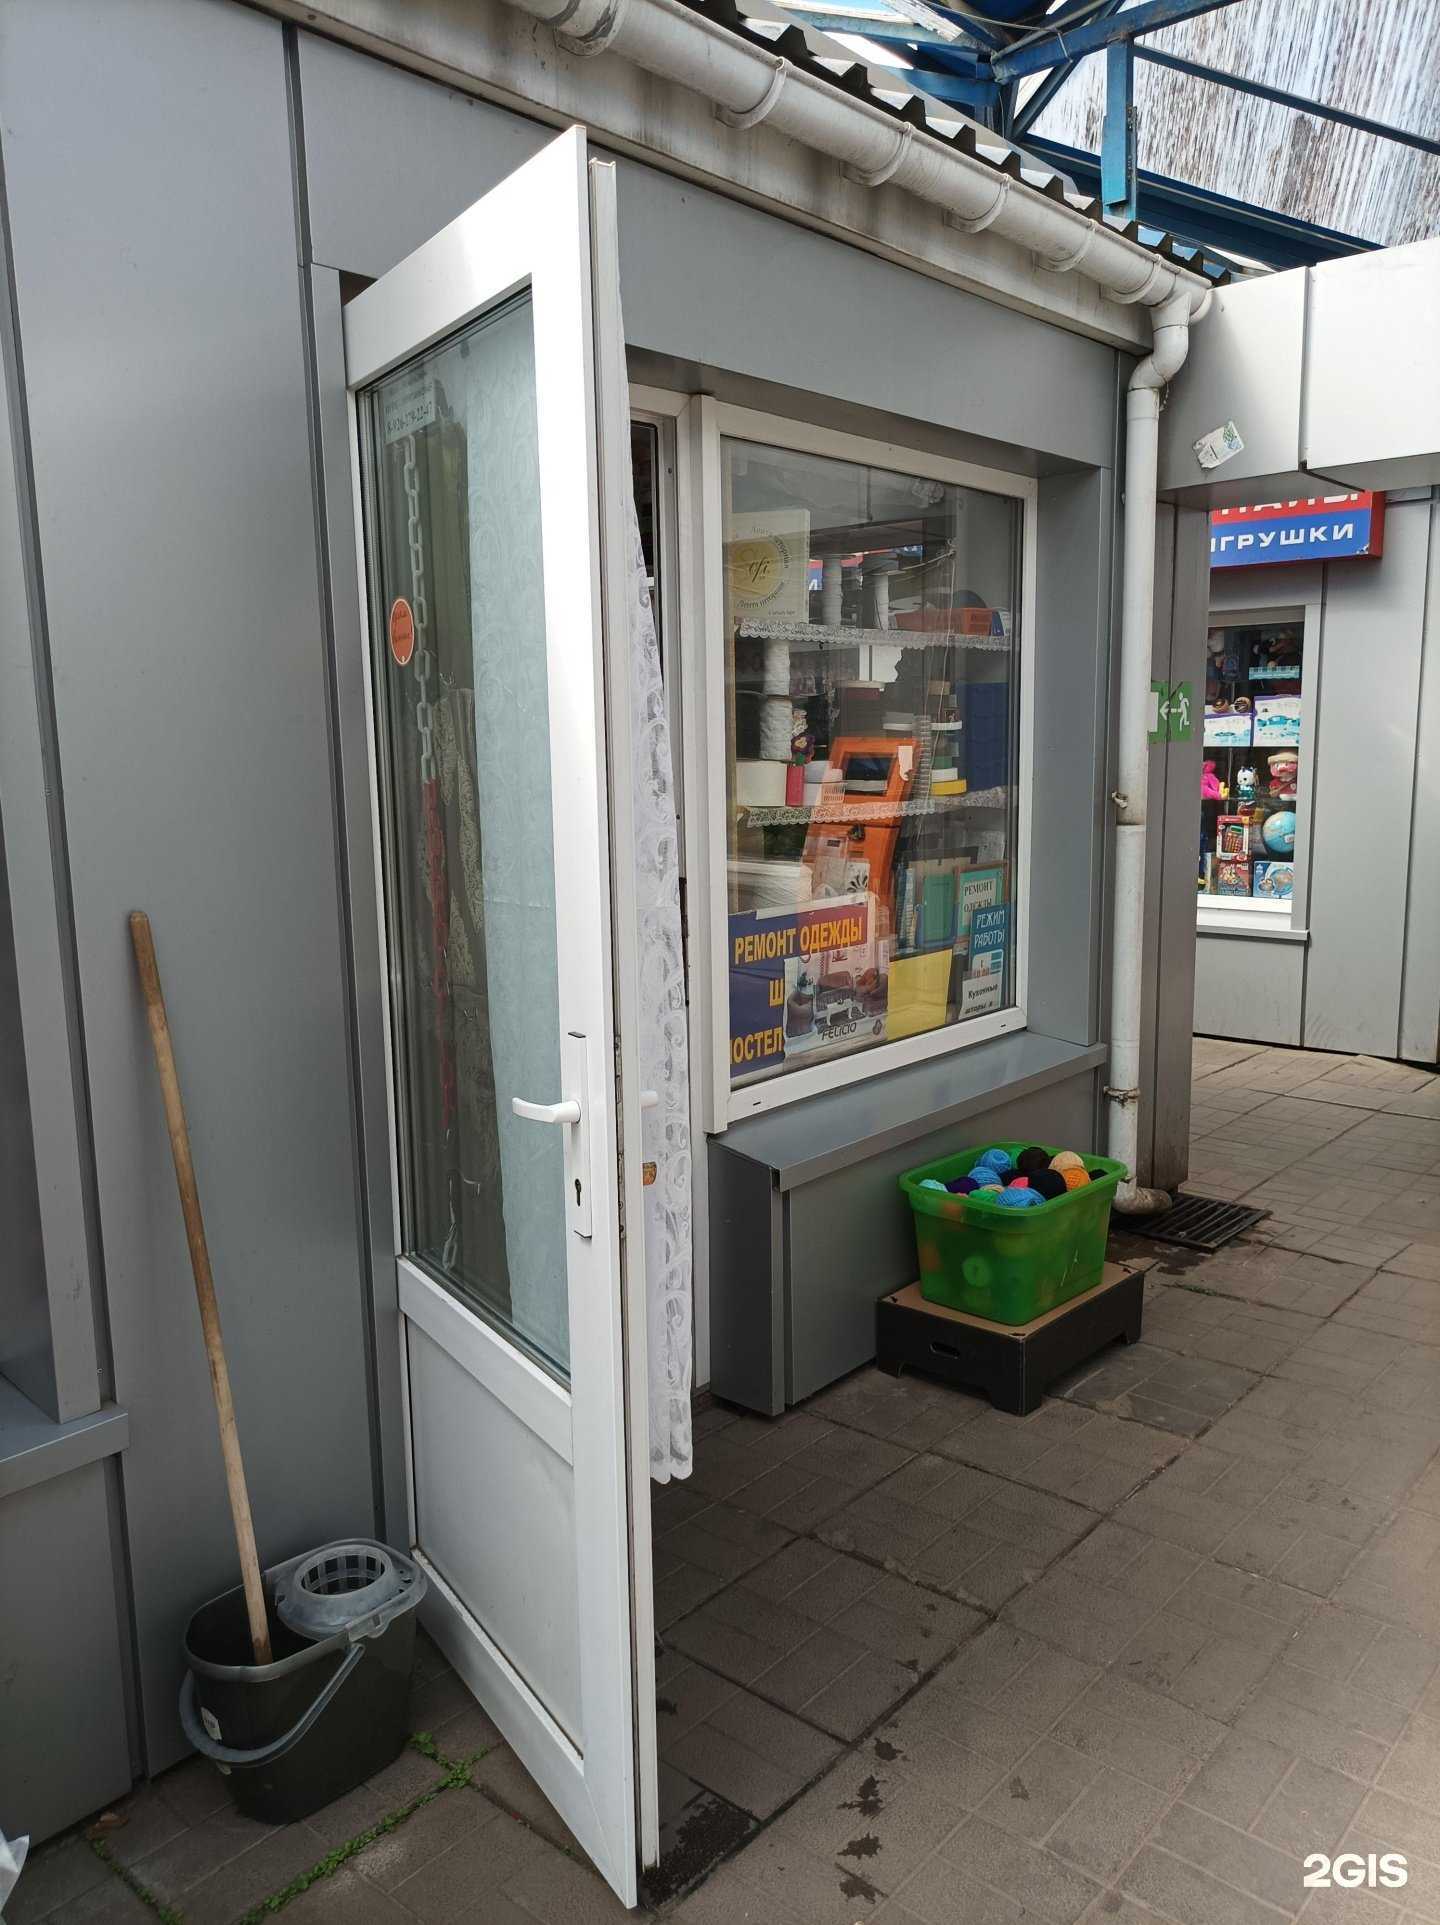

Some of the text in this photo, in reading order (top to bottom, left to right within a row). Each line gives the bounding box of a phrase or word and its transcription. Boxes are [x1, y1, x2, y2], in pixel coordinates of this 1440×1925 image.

[963, 880, 993, 896] РЕМОНТ
[976, 910, 1005, 928] РЕЖИМ
[734, 916, 863, 965] РЕМОНТ ОДЕЖДЫ
[974, 929, 1005, 949] РАБОТЫ
[821, 1022, 857, 1041] FELICIO
